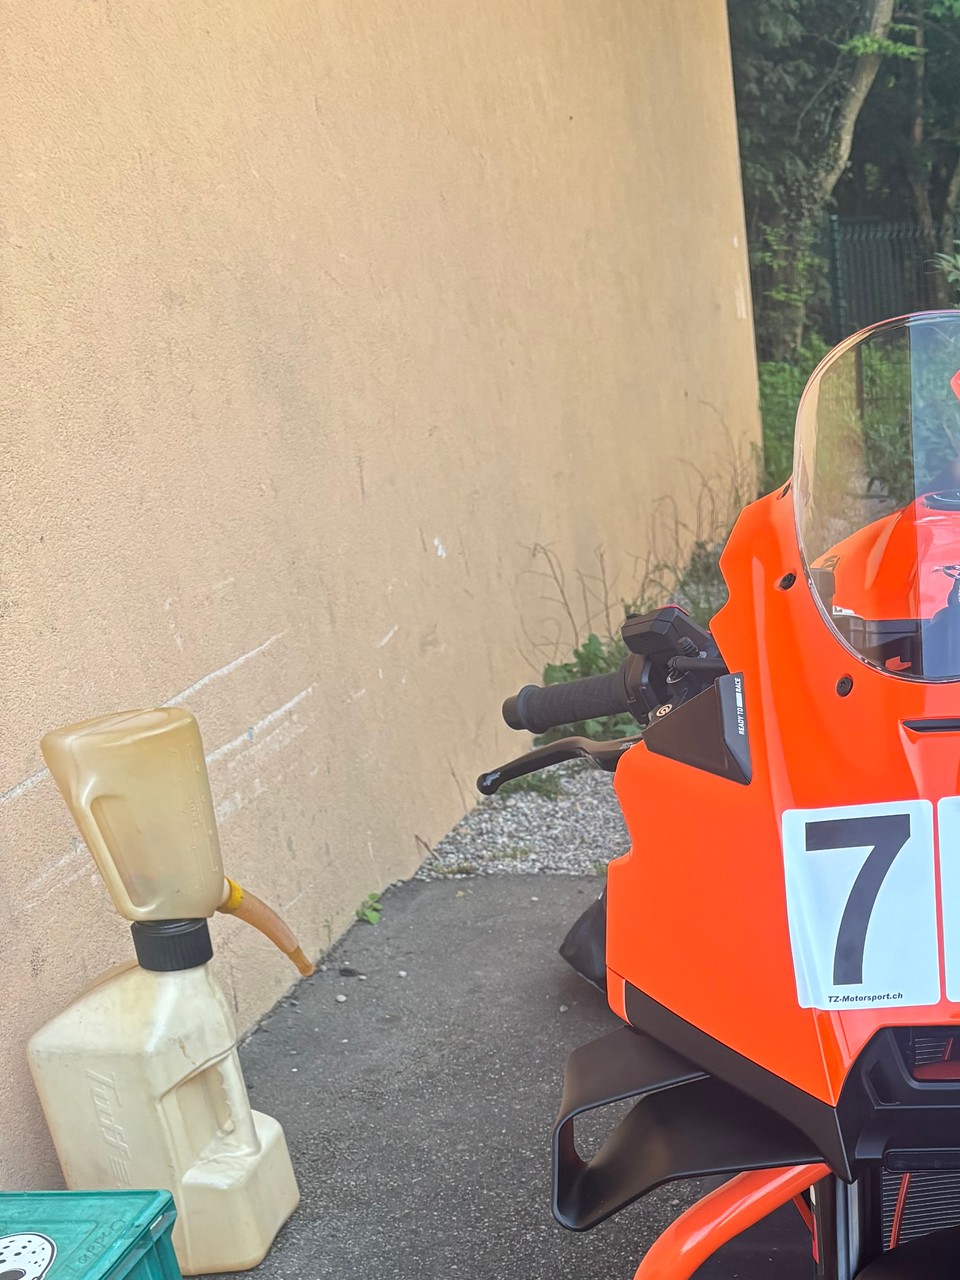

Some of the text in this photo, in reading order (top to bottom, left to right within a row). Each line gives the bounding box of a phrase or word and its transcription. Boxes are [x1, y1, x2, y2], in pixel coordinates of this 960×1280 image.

[734, 677, 745, 735] READY TO RACE
[827, 992, 903, 1004] TZ-Motorsport.ch
